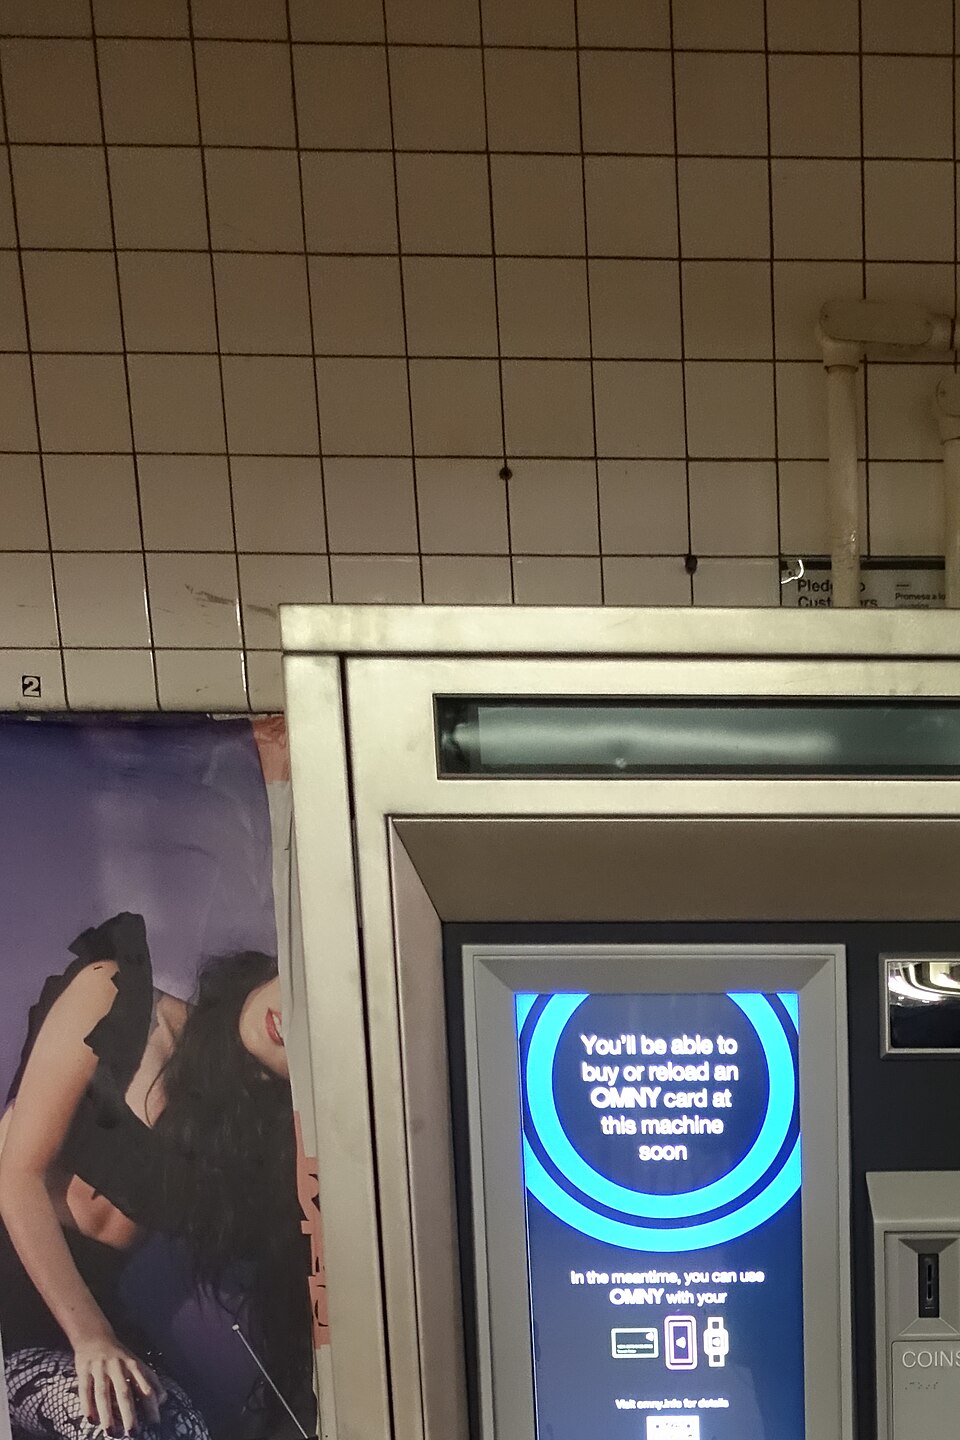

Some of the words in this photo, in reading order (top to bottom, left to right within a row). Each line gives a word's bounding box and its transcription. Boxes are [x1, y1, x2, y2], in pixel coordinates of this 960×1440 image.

[798, 580, 832, 594] Pled
[22, 676, 41, 697] 2
[581, 1035, 636, 1055] You'll
[642, 1036, 666, 1055] be
[671, 1036, 712, 1055] able
[717, 1036, 738, 1055] to
[582, 1063, 618, 1086] buy
[624, 1067, 646, 1082] or
[649, 1062, 710, 1082] reload
[714, 1066, 738, 1081] an
[590, 1087, 661, 1109] OMNY
[664, 1089, 708, 1108] card
[712, 1089, 732, 1108] at
[600, 1116, 636, 1135] this
[641, 1115, 724, 1135] machine
[638, 1145, 688, 1161] soon
[570, 1270, 584, 1284] In
[586, 1270, 609, 1284] the
[612, 1270, 681, 1285] meantime,
[684, 1272, 709, 1286] you
[712, 1272, 737, 1283] can
[740, 1270, 764, 1282] use
[609, 1288, 664, 1305] OMNY
[666, 1290, 694, 1304] with
[697, 1290, 727, 1307] your
